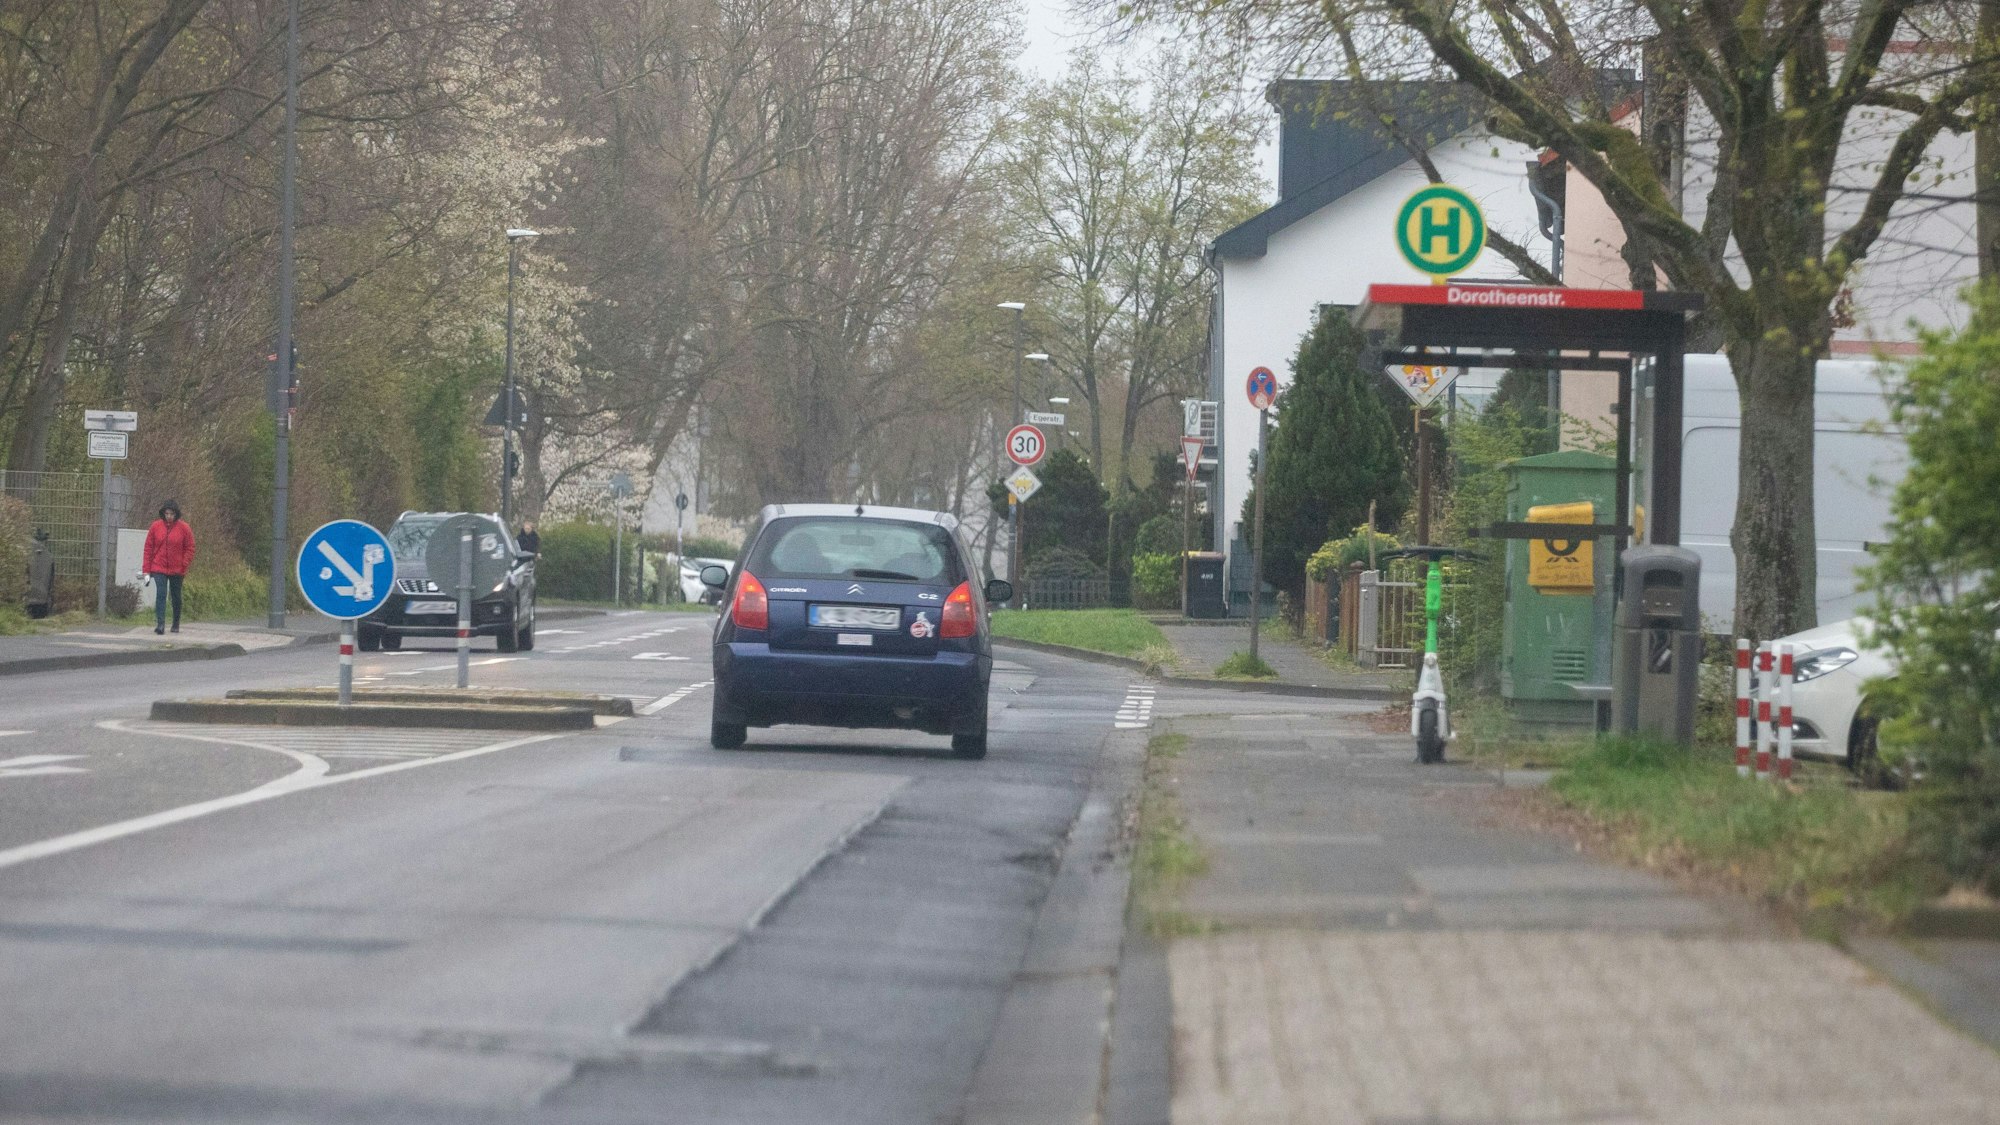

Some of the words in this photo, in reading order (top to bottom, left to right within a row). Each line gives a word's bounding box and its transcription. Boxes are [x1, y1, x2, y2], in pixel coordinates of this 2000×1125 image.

[1421, 207, 1460, 254] H
[1447, 287, 1566, 306] Dorotheenstr.
[1033, 414, 1061, 423] Egerstr.
[1015, 435, 1037, 453] 30
